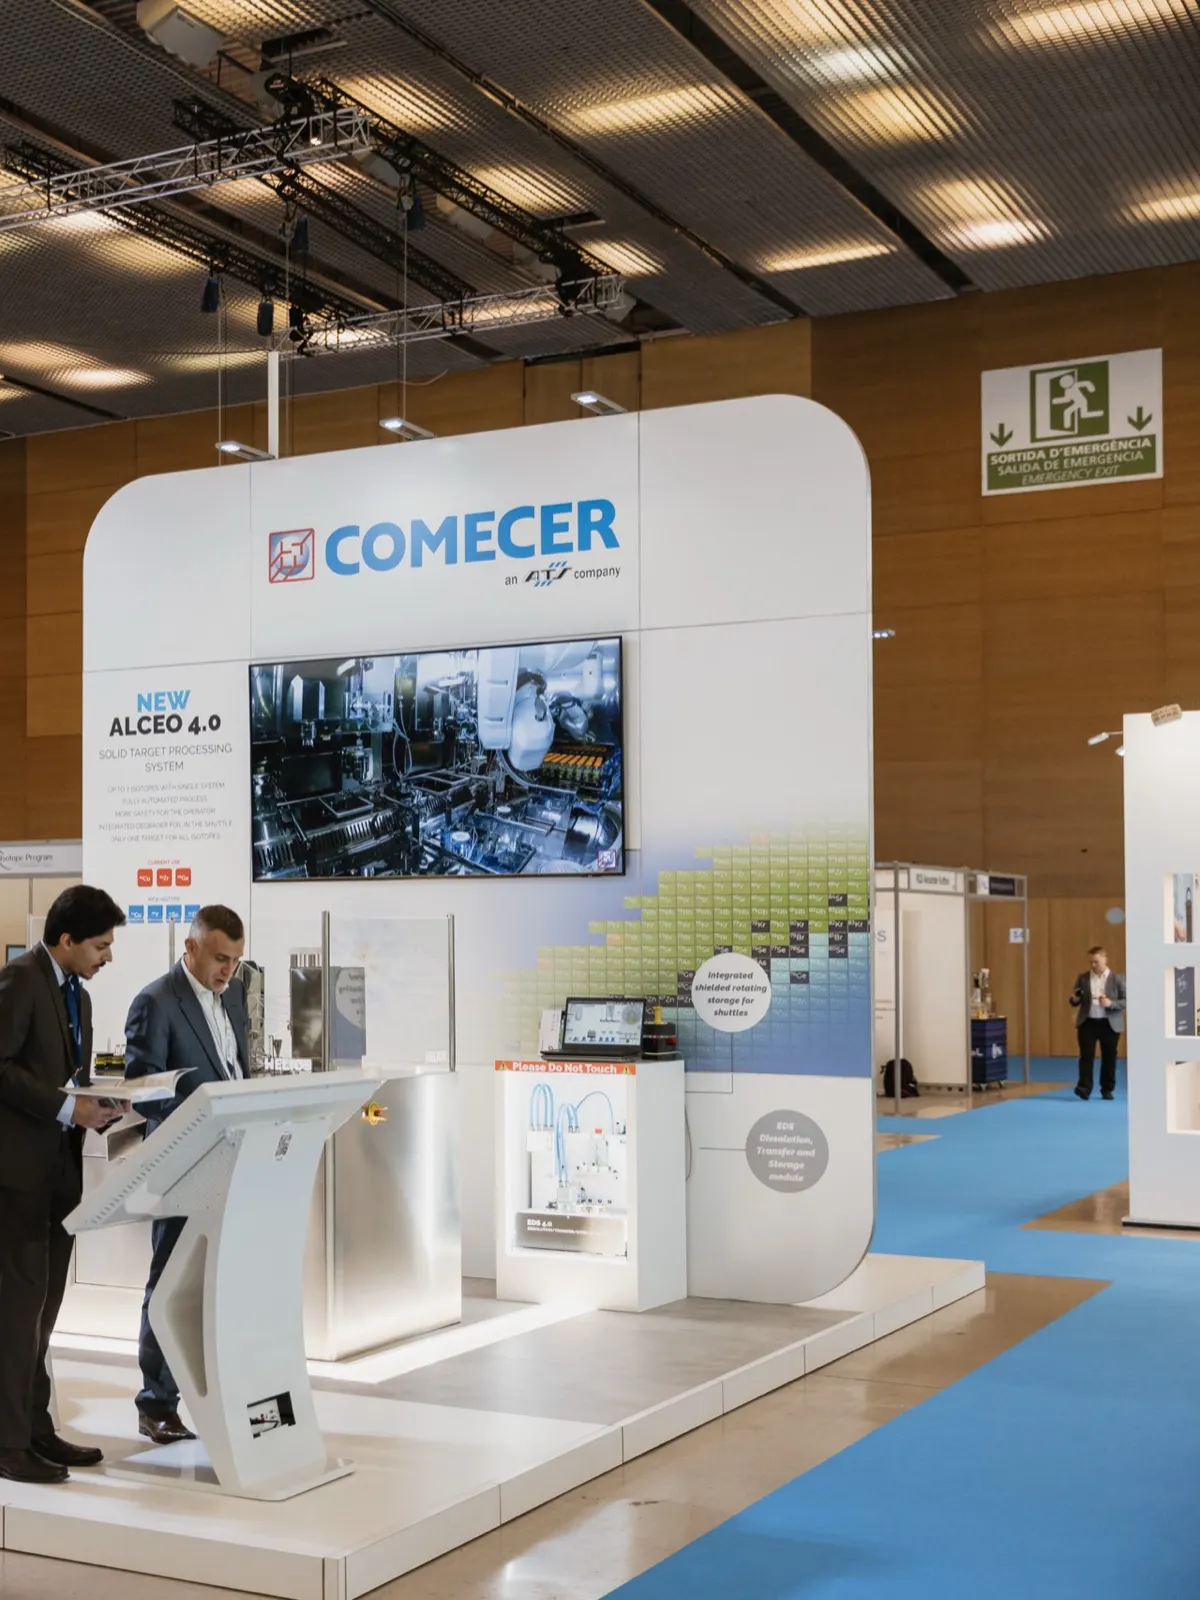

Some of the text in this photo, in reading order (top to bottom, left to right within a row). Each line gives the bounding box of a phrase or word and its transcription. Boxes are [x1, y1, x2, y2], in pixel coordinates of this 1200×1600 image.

[990, 450, 1046, 466] SORTIDA
[997, 451, 1144, 476] SALIDA DE EMERGENCIA
[1022, 465, 1121, 486] EMERGENCY EXIT
[325, 498, 620, 577] COMECER
[505, 565, 621, 585] an ATS company
[137, 690, 191, 713] NEW
[109, 713, 221, 737] ALCEO 4.0
[99, 743, 232, 760] SOLID TARGET PROCESSING
[145, 761, 184, 773] SYSTEM
[25, 853, 54, 864] Program
[708, 971, 753, 980] Integrated
[732, 984, 768, 993] rotating
[707, 996, 754, 1006] storage for
[714, 1009, 748, 1017] shuttles
[512, 1061, 617, 1074] Please Do Not Touch
[760, 1134, 813, 1145] Dissolution,
[757, 1146, 816, 1157] Transfer and
[768, 1160, 805, 1171] Storage
[768, 1173, 804, 1182] module
